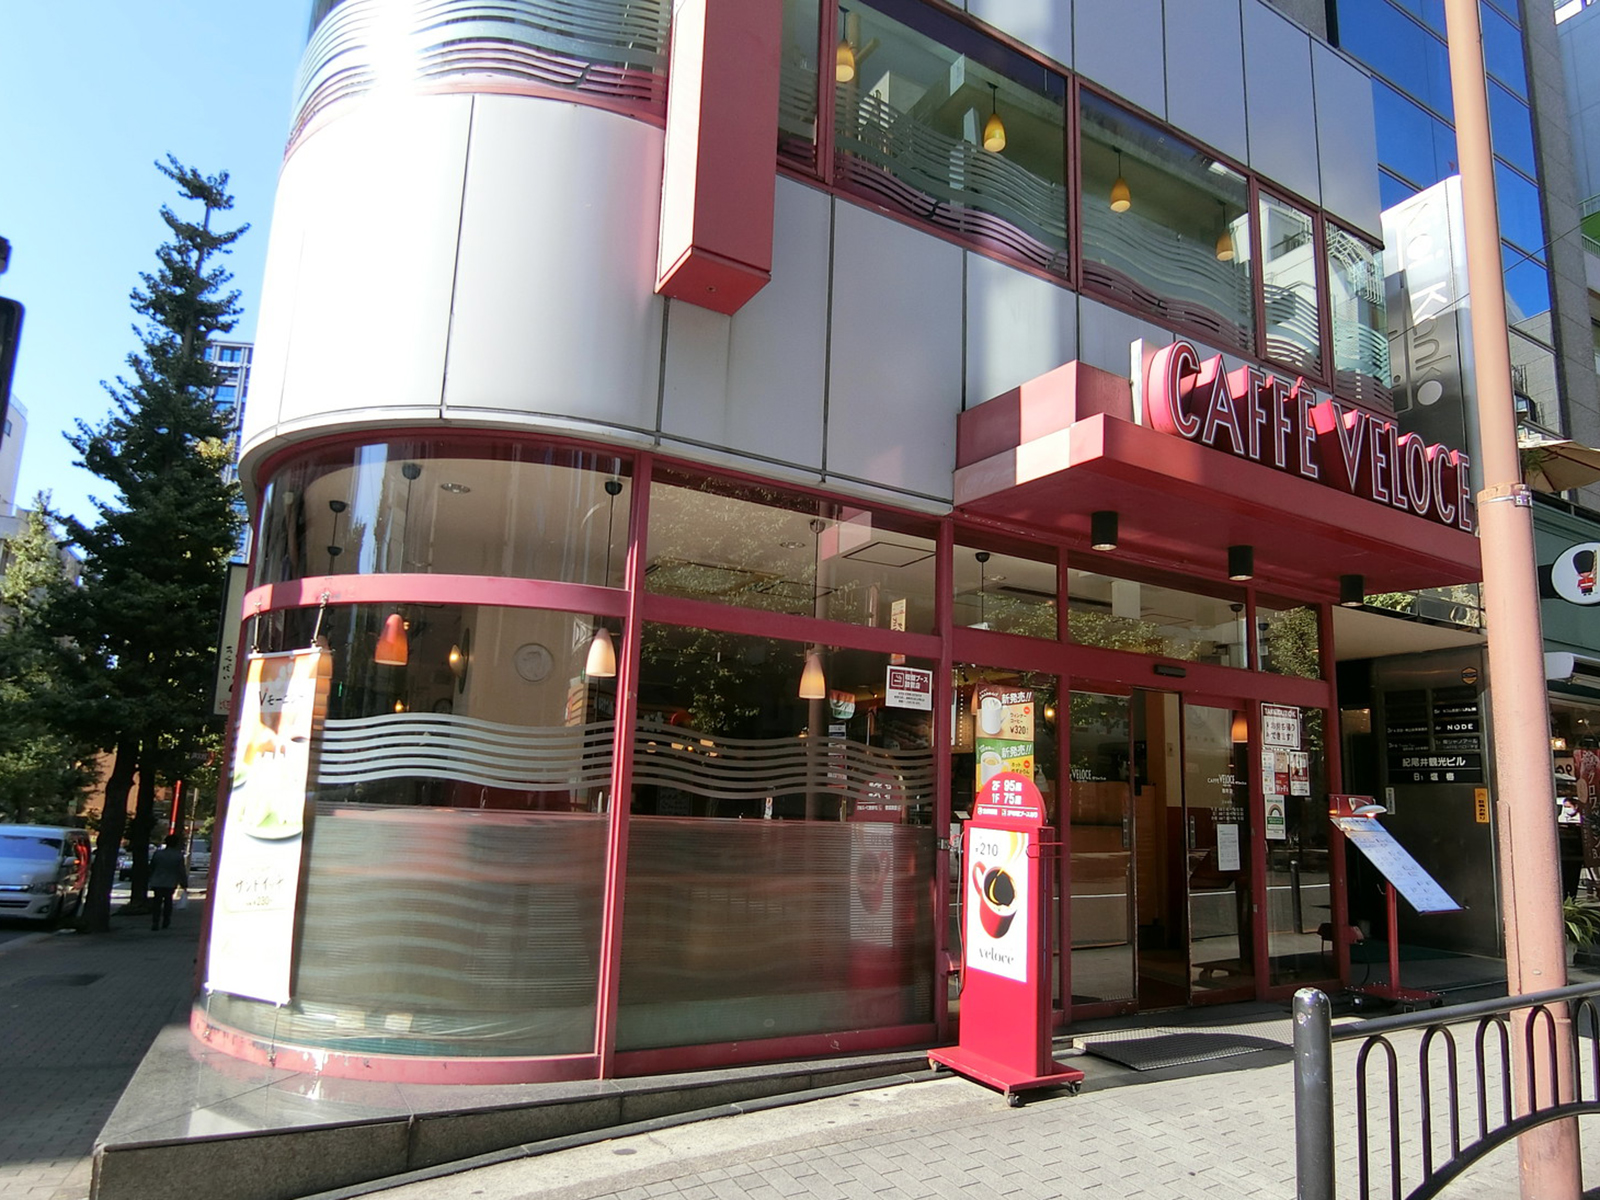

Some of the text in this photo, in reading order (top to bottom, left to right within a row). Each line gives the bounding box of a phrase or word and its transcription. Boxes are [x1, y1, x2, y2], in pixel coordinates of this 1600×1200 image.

[1411, 281, 1451, 406] Kanko
[1332, 401, 1472, 532] VELOCE
[1447, 723, 1473, 731] NODE
[1402, 756, 1466, 767] 紀尾井観光ビル
[1071, 768, 1091, 780] VELOCE
[991, 780, 1001, 791] 2F
[991, 793, 1000, 804] 1F
[979, 947, 1014, 965] veloce
